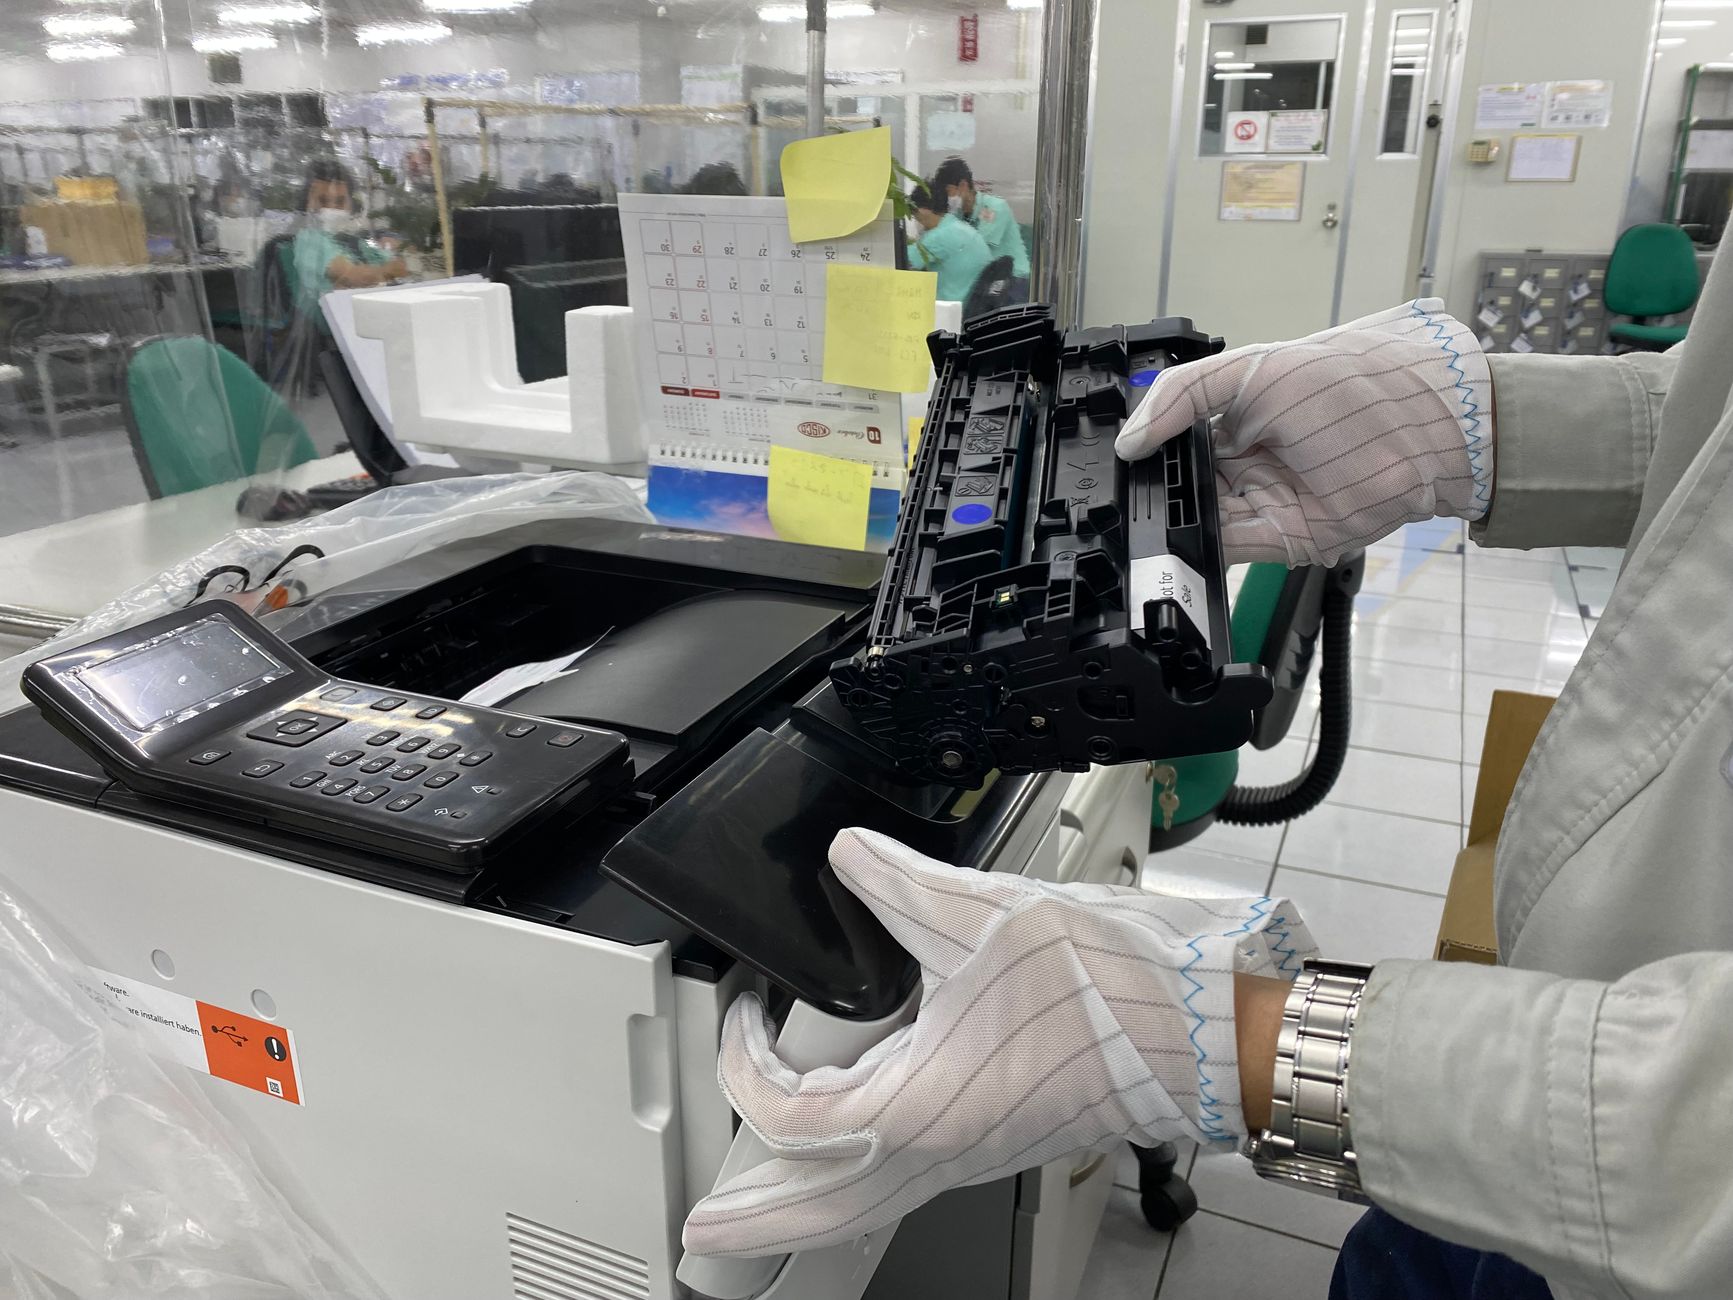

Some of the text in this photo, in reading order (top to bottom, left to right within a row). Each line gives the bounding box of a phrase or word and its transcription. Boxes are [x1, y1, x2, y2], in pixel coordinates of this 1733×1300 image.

[660, 244, 870, 261] 24 25 26 27 28 29 30
[665, 278, 803, 294] 19 20 21 22 23
[732, 316, 741, 324] 14
[763, 318, 773, 326] 13
[796, 320, 805, 328] 12
[868, 392, 878, 400] 31
[800, 423, 827, 437] KISCO
[867, 430, 880, 441] 10
[1159, 571, 1173, 584] for
[140, 1010, 175, 1029] installiert
[176, 1022, 202, 1037] haben.
